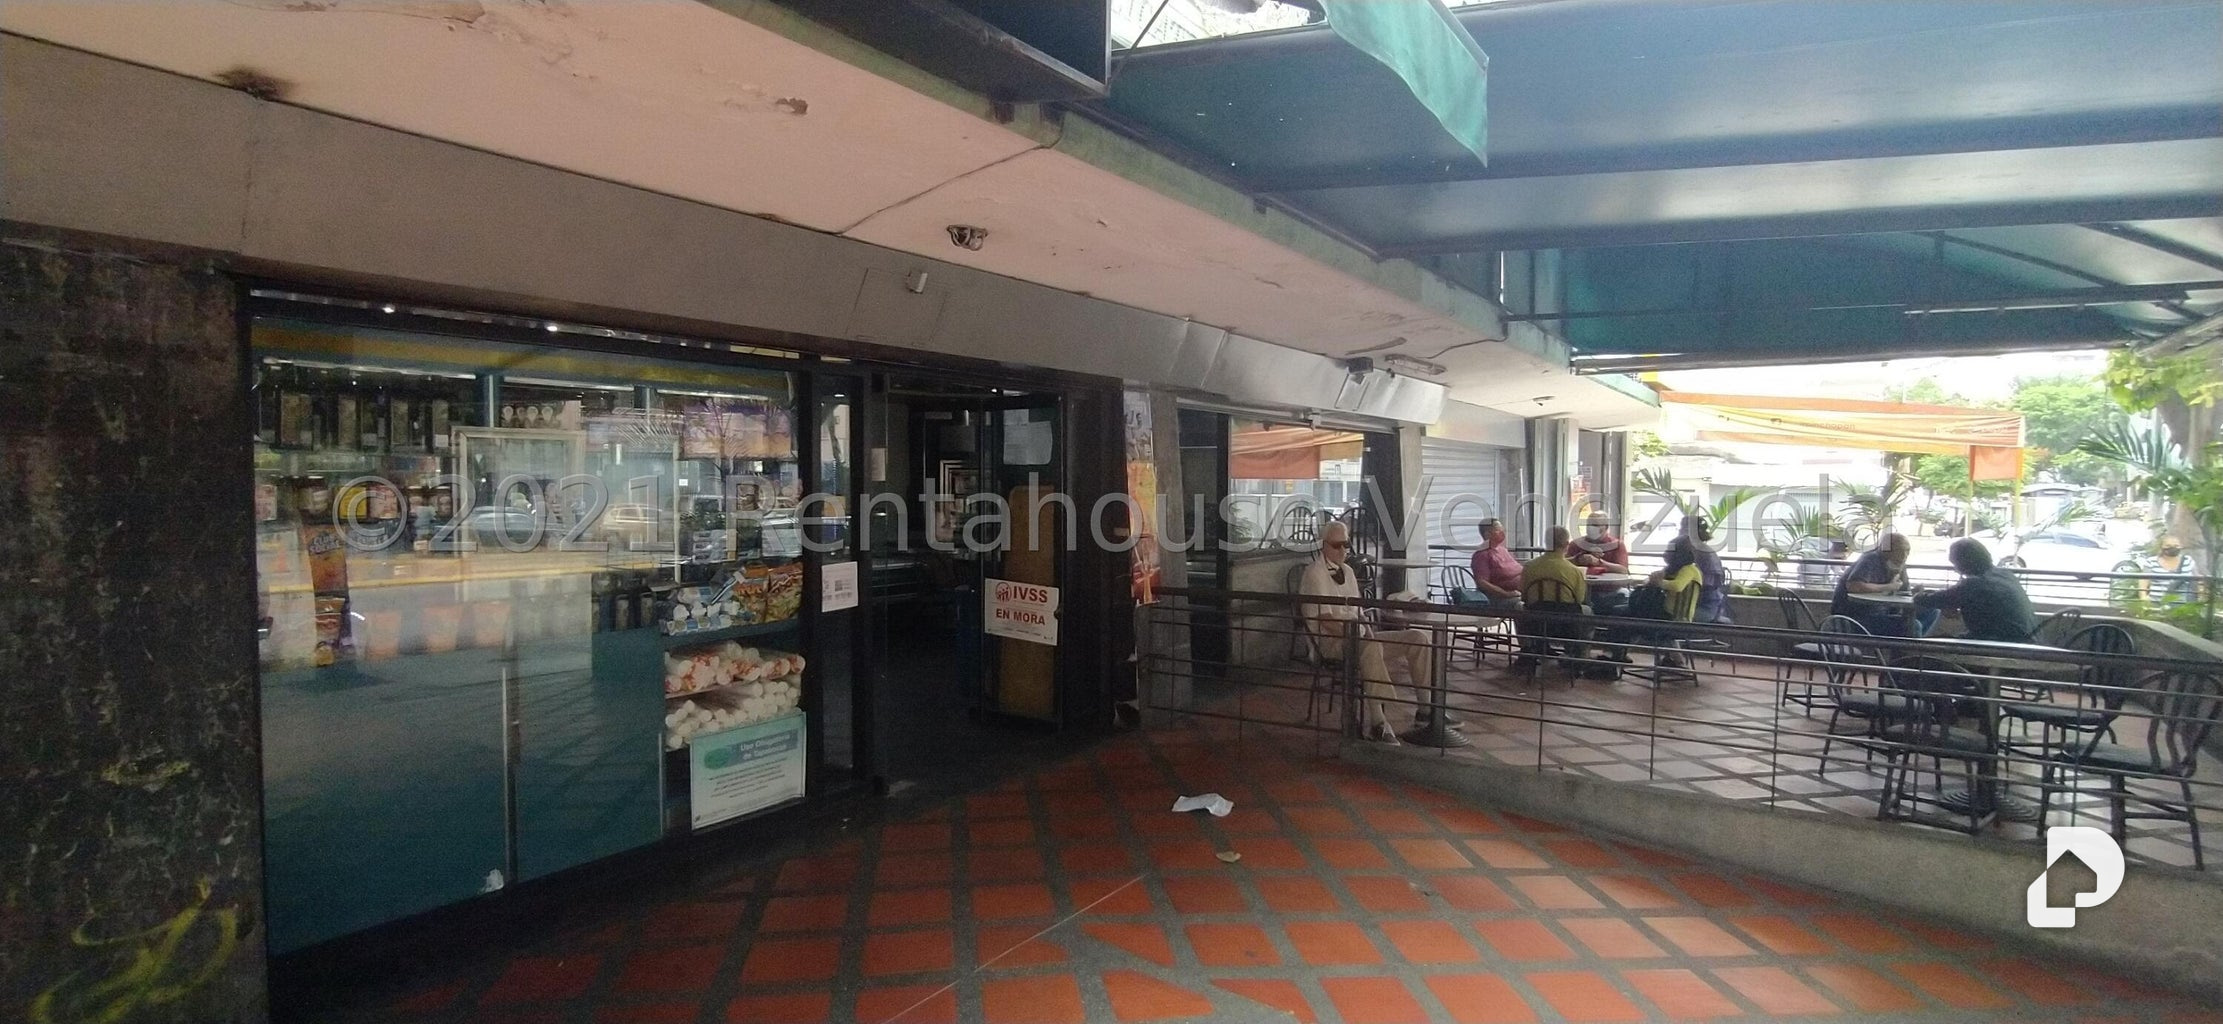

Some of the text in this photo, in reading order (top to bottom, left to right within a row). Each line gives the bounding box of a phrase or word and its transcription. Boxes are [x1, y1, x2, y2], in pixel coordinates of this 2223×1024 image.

[1013, 586, 1048, 603] IVSS
[996, 608, 1046, 626] EN MORA
